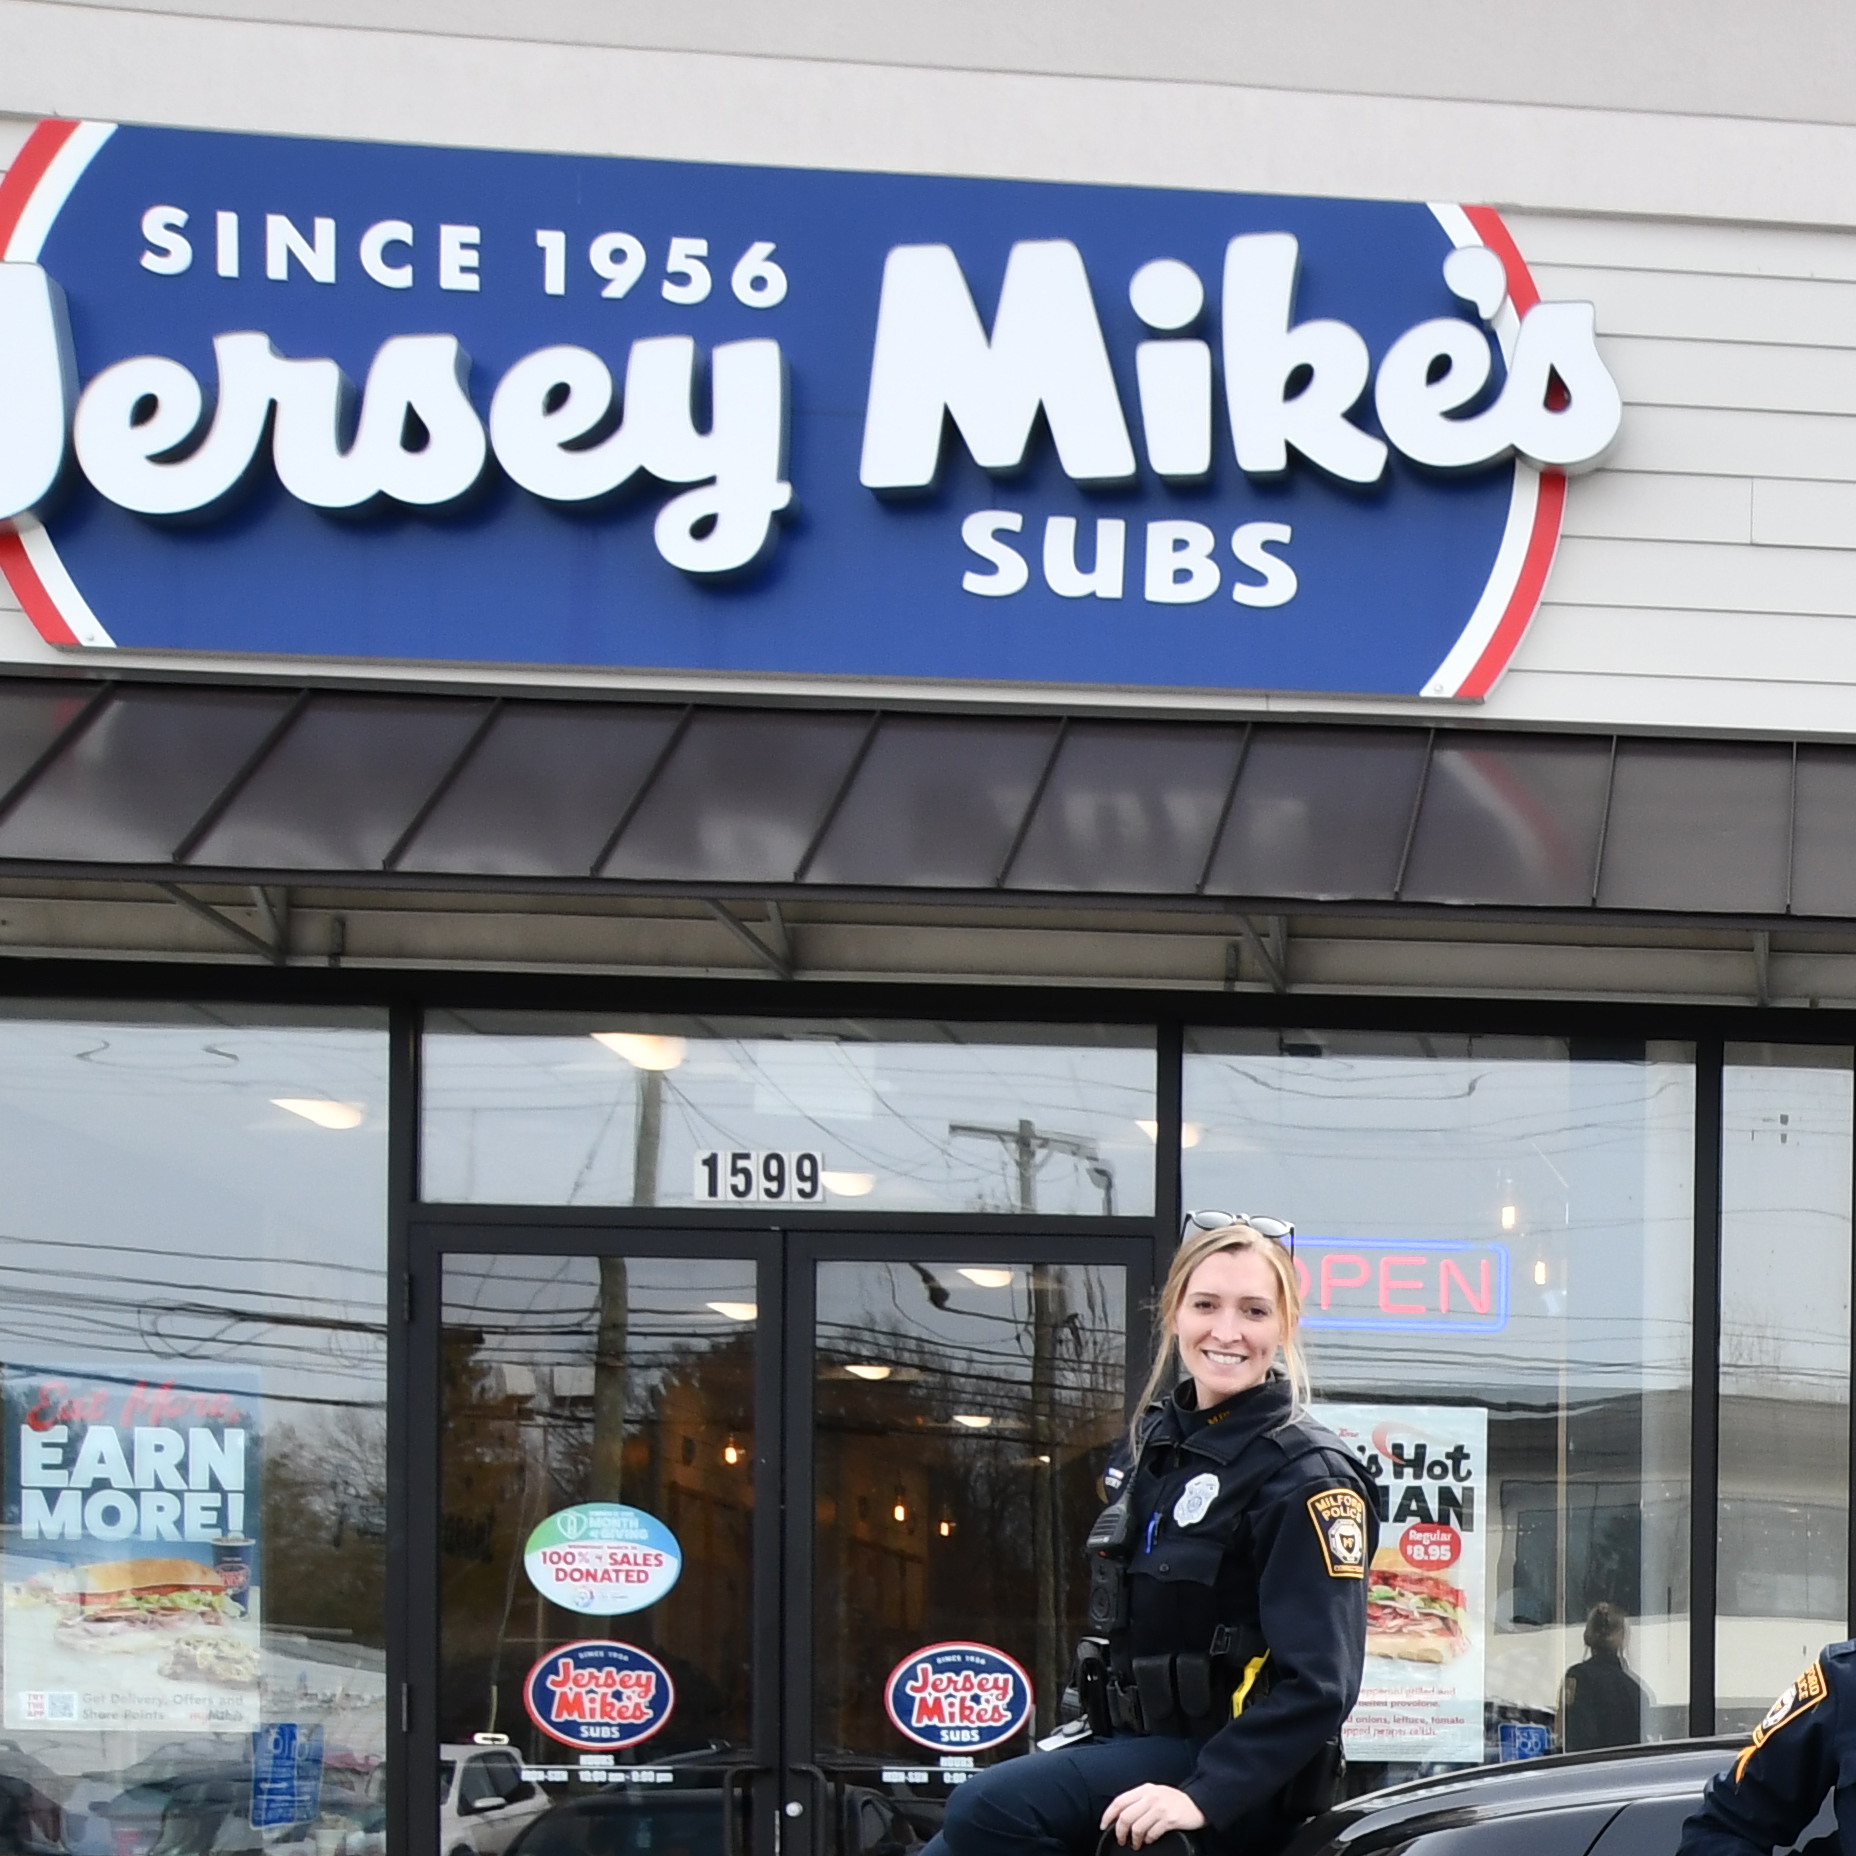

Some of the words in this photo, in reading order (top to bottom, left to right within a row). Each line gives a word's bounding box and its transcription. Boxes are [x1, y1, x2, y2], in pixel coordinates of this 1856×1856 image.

[138, 205, 482, 292] SINCE
[536, 229, 789, 309] 1956
[860, 231, 1622, 492] Mike's
[961, 509, 1298, 607] SUBS
[701, 1152, 819, 1199] 1599
[21, 1424, 245, 1491] EARN
[1391, 1442, 1473, 1483] Hot
[21, 1488, 245, 1543] MORE!
[1315, 1494, 1362, 1513] MILFORD
[1321, 1505, 1362, 1524] POLICE
[1406, 1544, 1452, 1561] $8.95
[1408, 1530, 1453, 1545] Regular
[554, 1567, 650, 1584] DONATED
[608, 1552, 664, 1568] SALES
[547, 1659, 656, 1699] Jersey
[907, 1664, 1013, 1703] Jersey
[552, 1688, 653, 1722] Mike's
[913, 1694, 1011, 1725] Mike's
[1431, 1716, 1465, 1724] tomato
[579, 1725, 620, 1739] SUBS
[939, 1729, 980, 1742] SUBS
